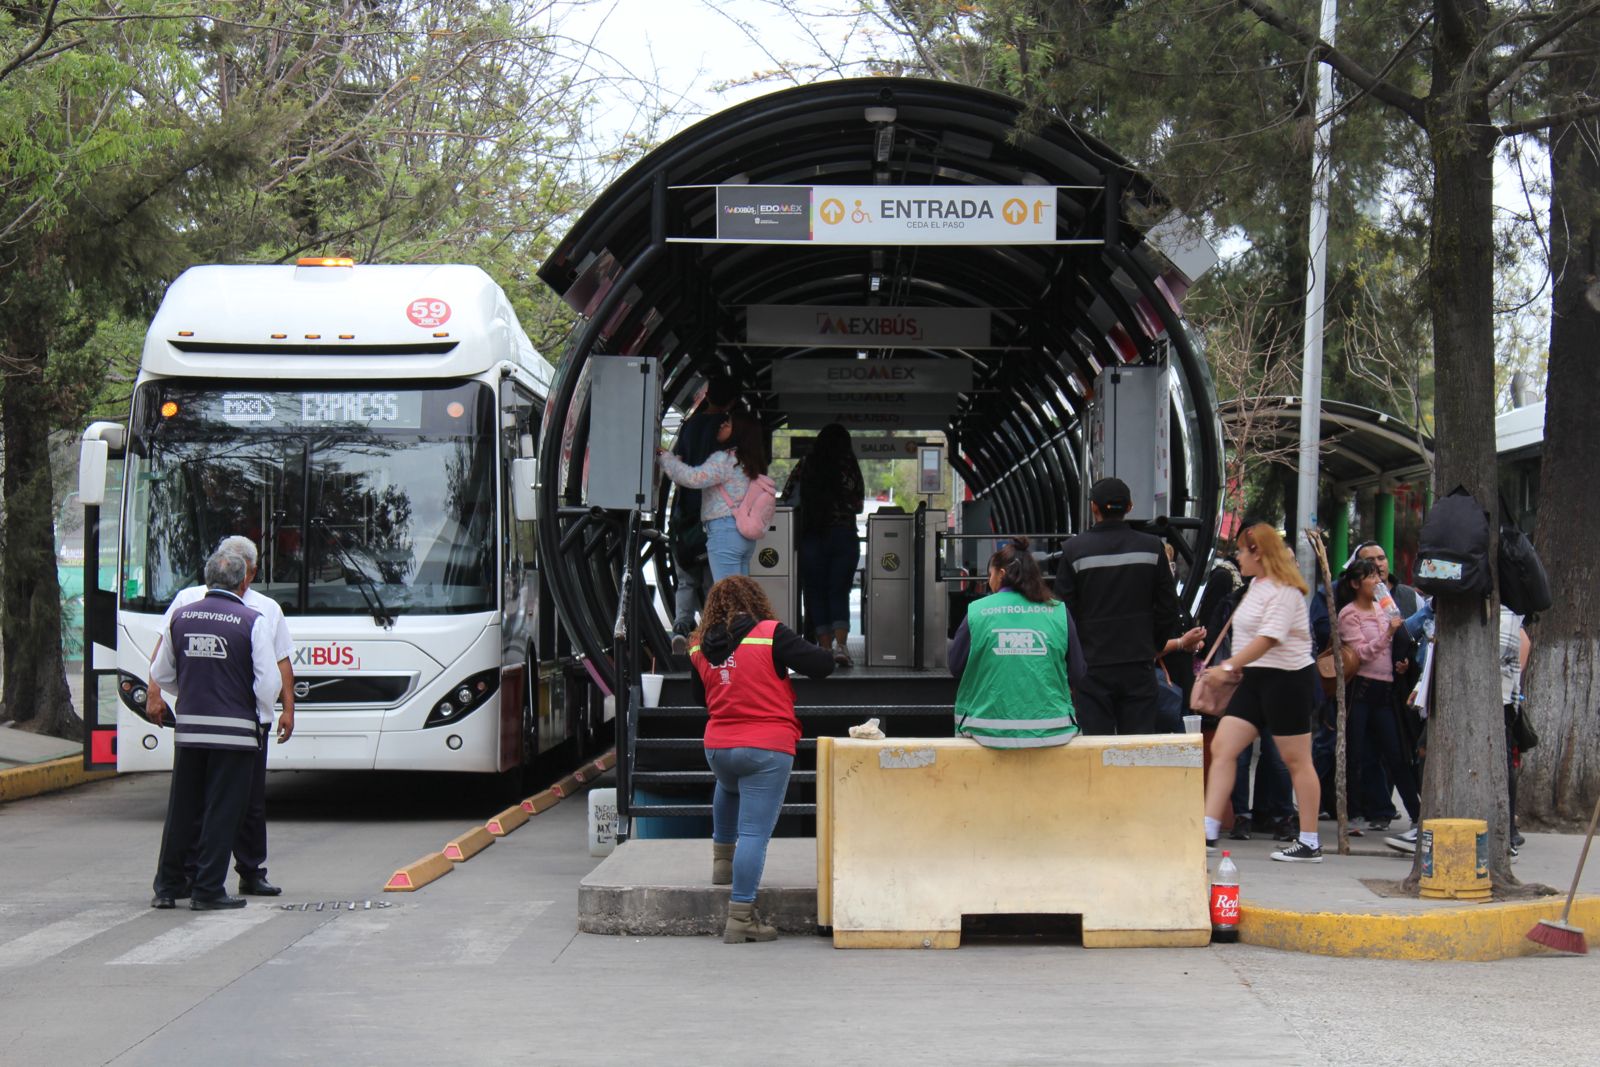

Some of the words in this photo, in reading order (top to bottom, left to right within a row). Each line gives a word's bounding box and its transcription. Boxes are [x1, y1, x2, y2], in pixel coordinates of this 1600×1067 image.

[881, 200, 994, 219] ENTRADA
[906, 221, 929, 229] CEDA
[930, 221, 941, 229] EL
[942, 221, 965, 229] PASO
[411, 301, 446, 319] 59
[819, 314, 918, 336] MEXIBÚS
[302, 393, 400, 421] EXPRESS
[860, 443, 897, 453] SALIDA
[181, 611, 241, 625] SUPERVISIÓN
[981, 605, 1054, 616] CONTROLADOR
[292, 642, 354, 666] XIBÚS
[1215, 894, 1239, 909] Red
